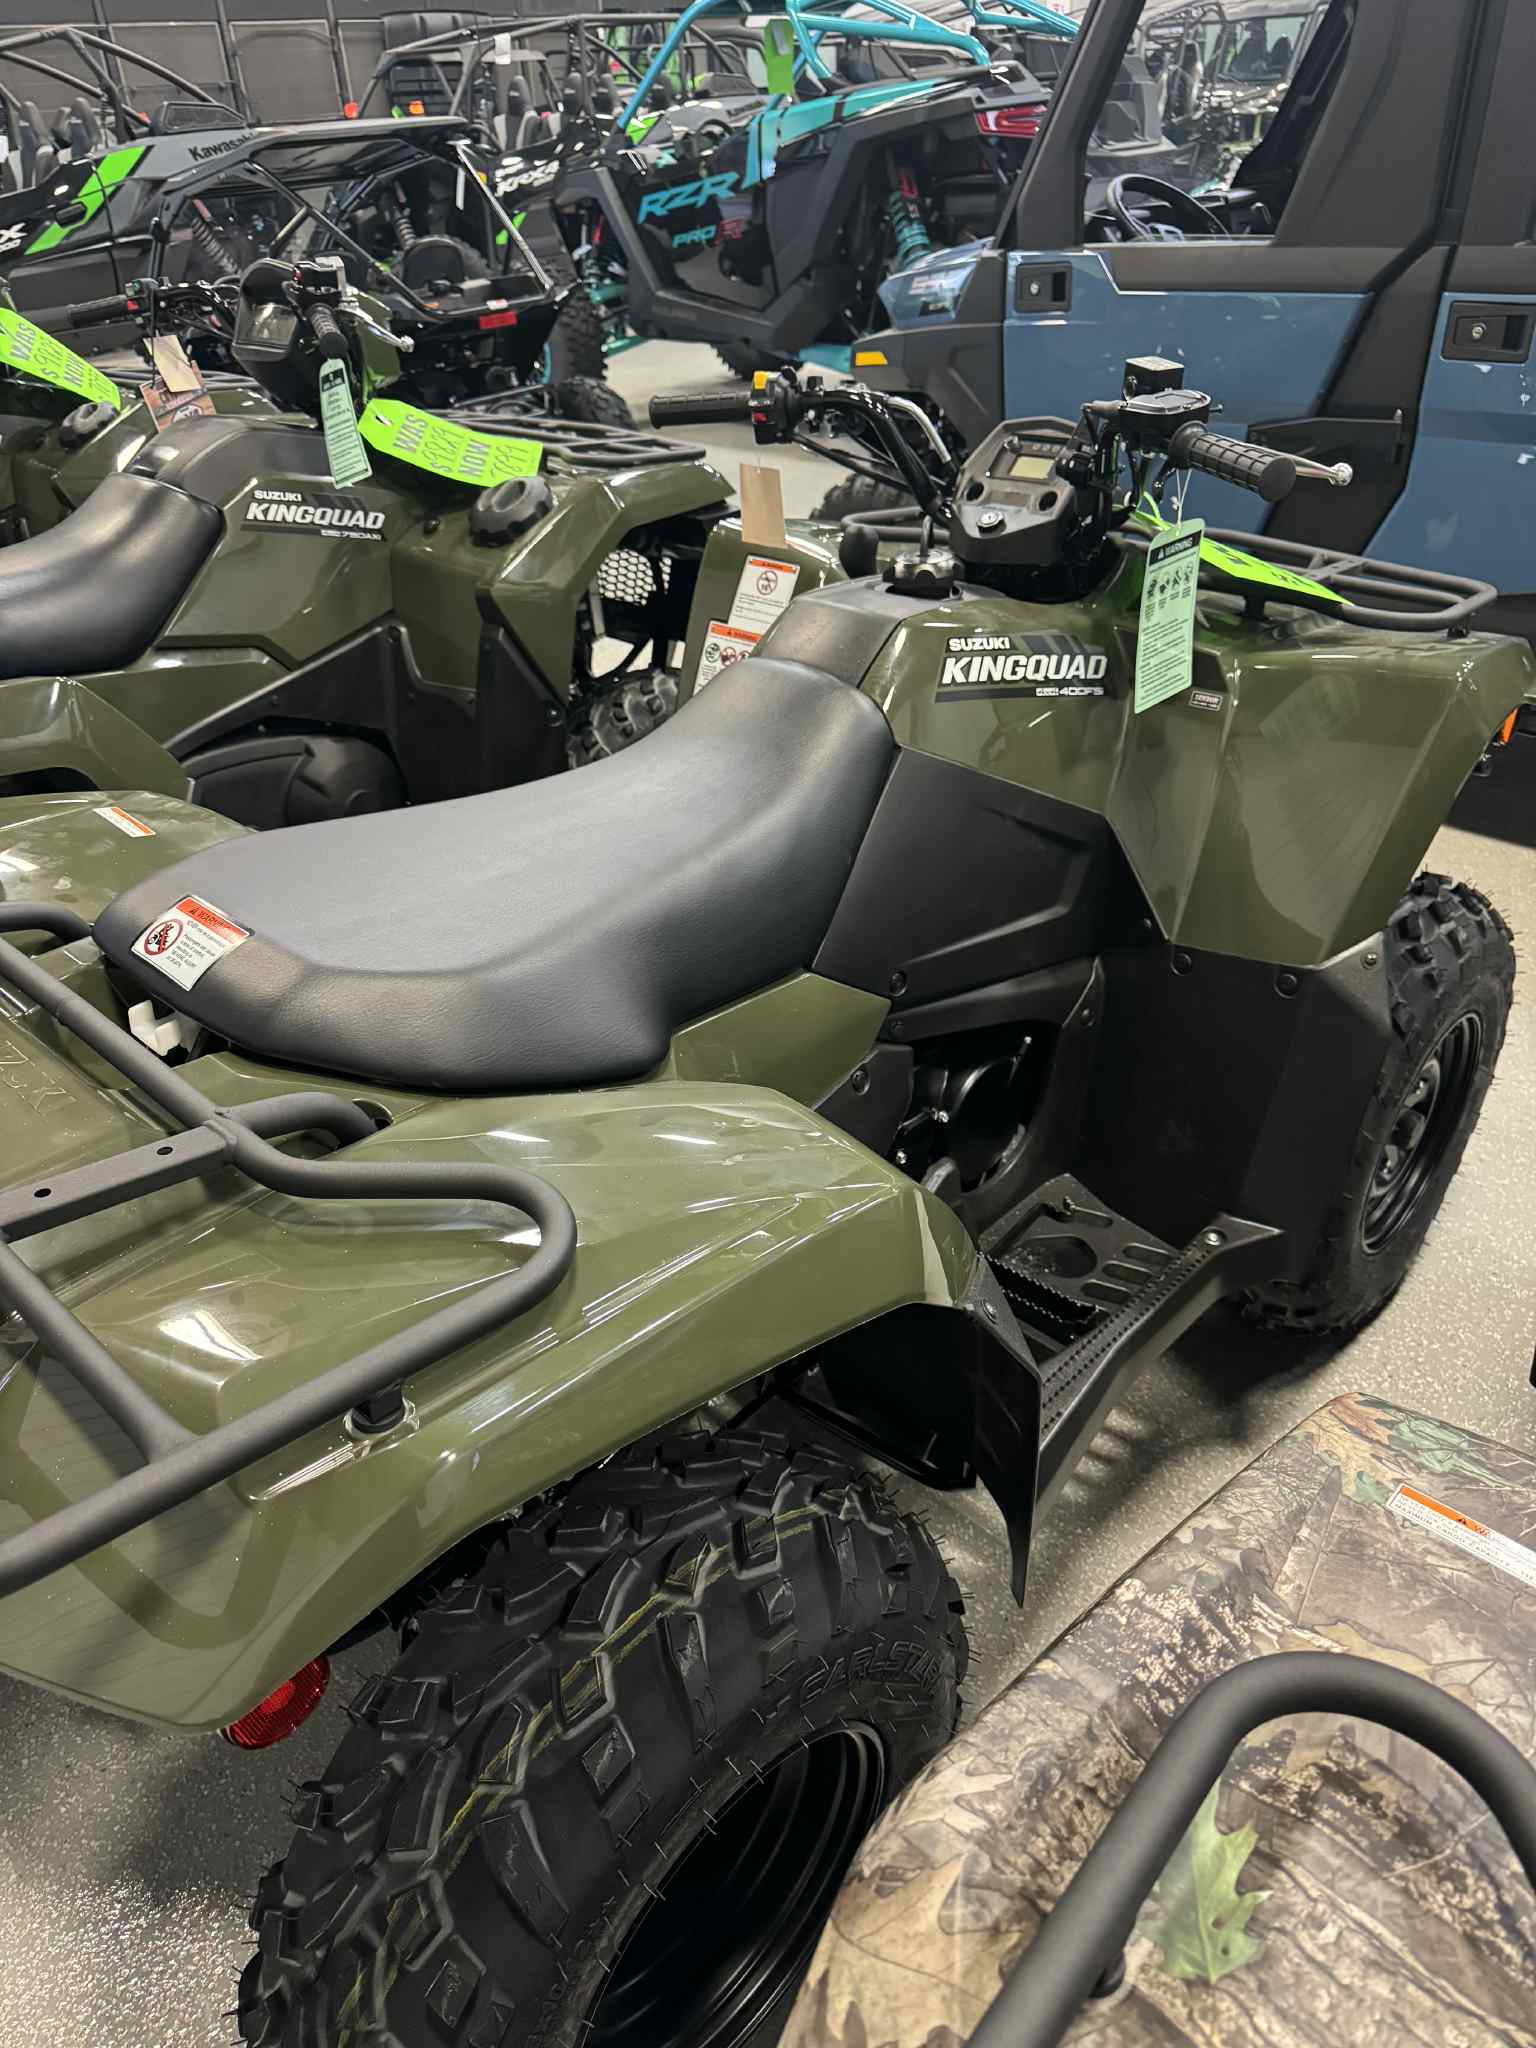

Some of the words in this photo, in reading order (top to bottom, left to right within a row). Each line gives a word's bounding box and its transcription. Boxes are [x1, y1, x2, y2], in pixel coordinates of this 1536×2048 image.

[637, 171, 740, 224] RZR
[671, 224, 717, 249] PRO
[10, 322, 36, 361] WAS
[393, 413, 428, 454] WAS
[458, 439, 491, 478] NOW
[254, 489, 302, 502] SUZUKI
[246, 502, 386, 530] KINGQUAD
[949, 636, 1011, 652] SUZUKI
[941, 653, 1108, 685] KINGQUAD
